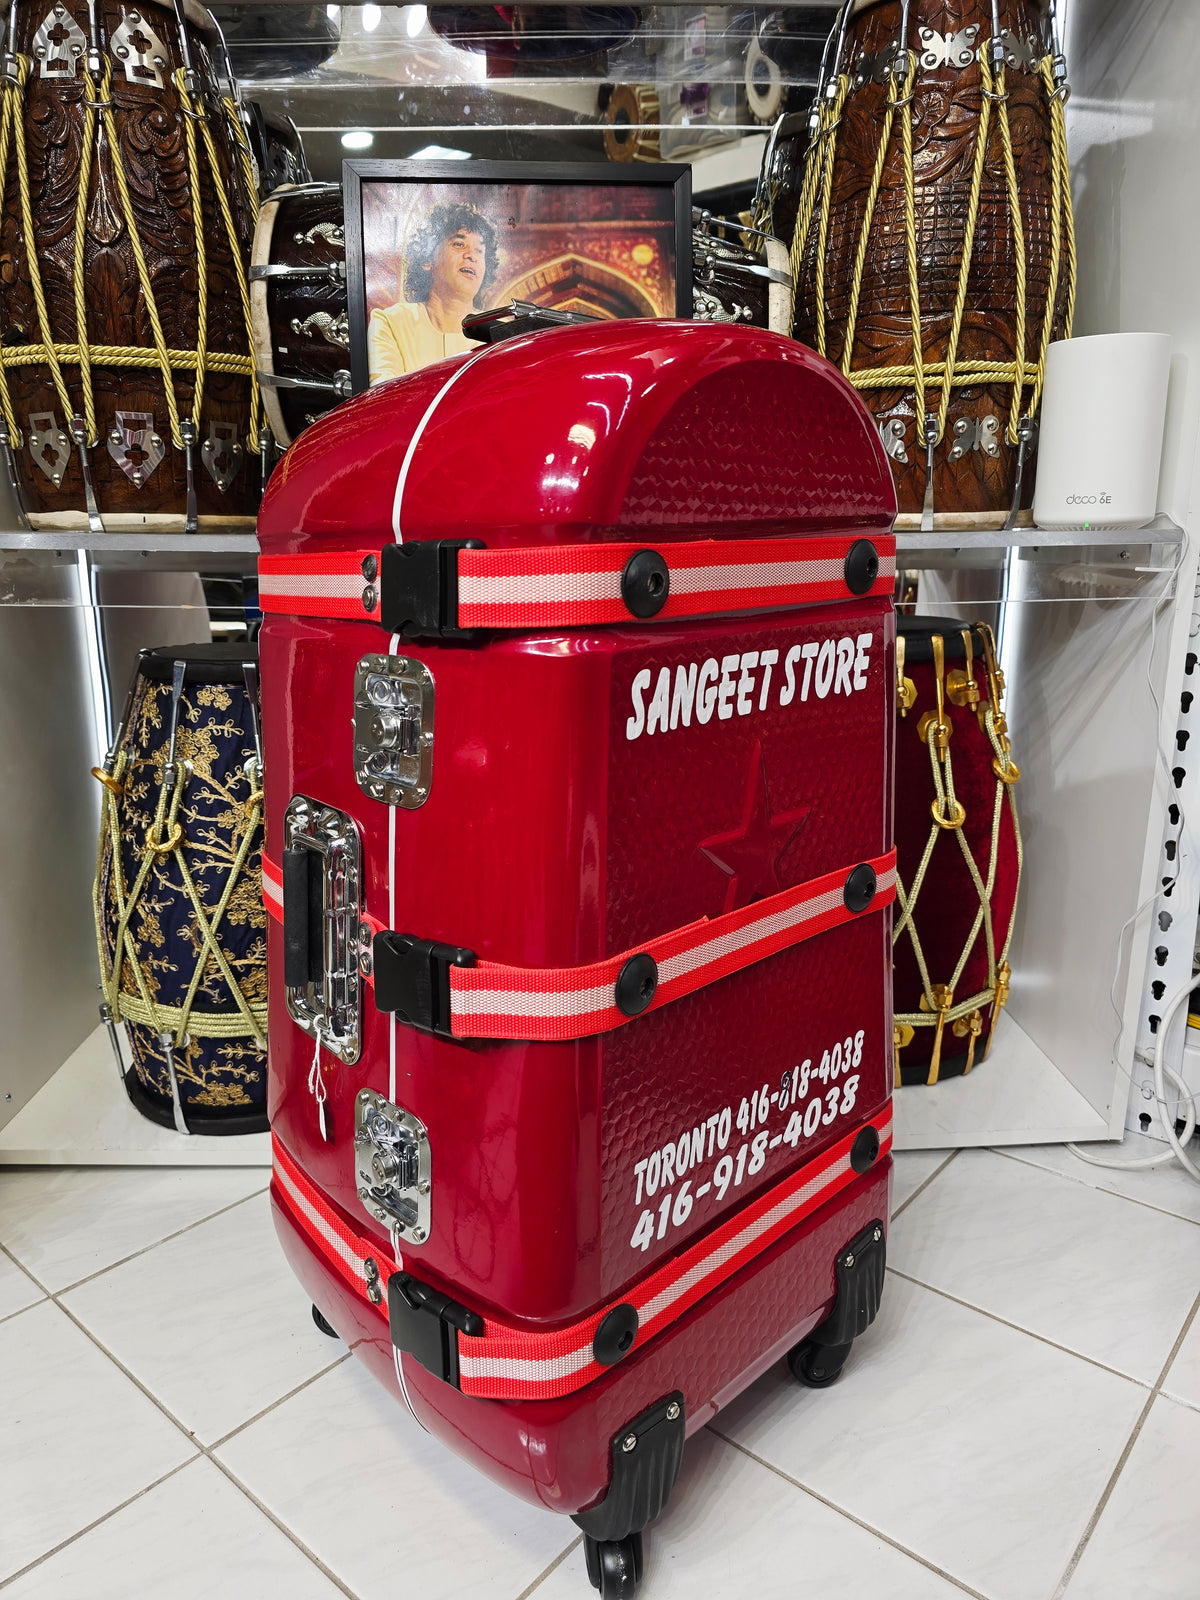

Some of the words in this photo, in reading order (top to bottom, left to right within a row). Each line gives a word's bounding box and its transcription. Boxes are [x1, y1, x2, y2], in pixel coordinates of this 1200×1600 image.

[1065, 494, 1097, 505] deco
[626, 649, 779, 741] SANGEET
[779, 632, 873, 706] STORE
[629, 1074, 861, 1252] 416-918-4038
[633, 1106, 731, 1205] TORONTO
